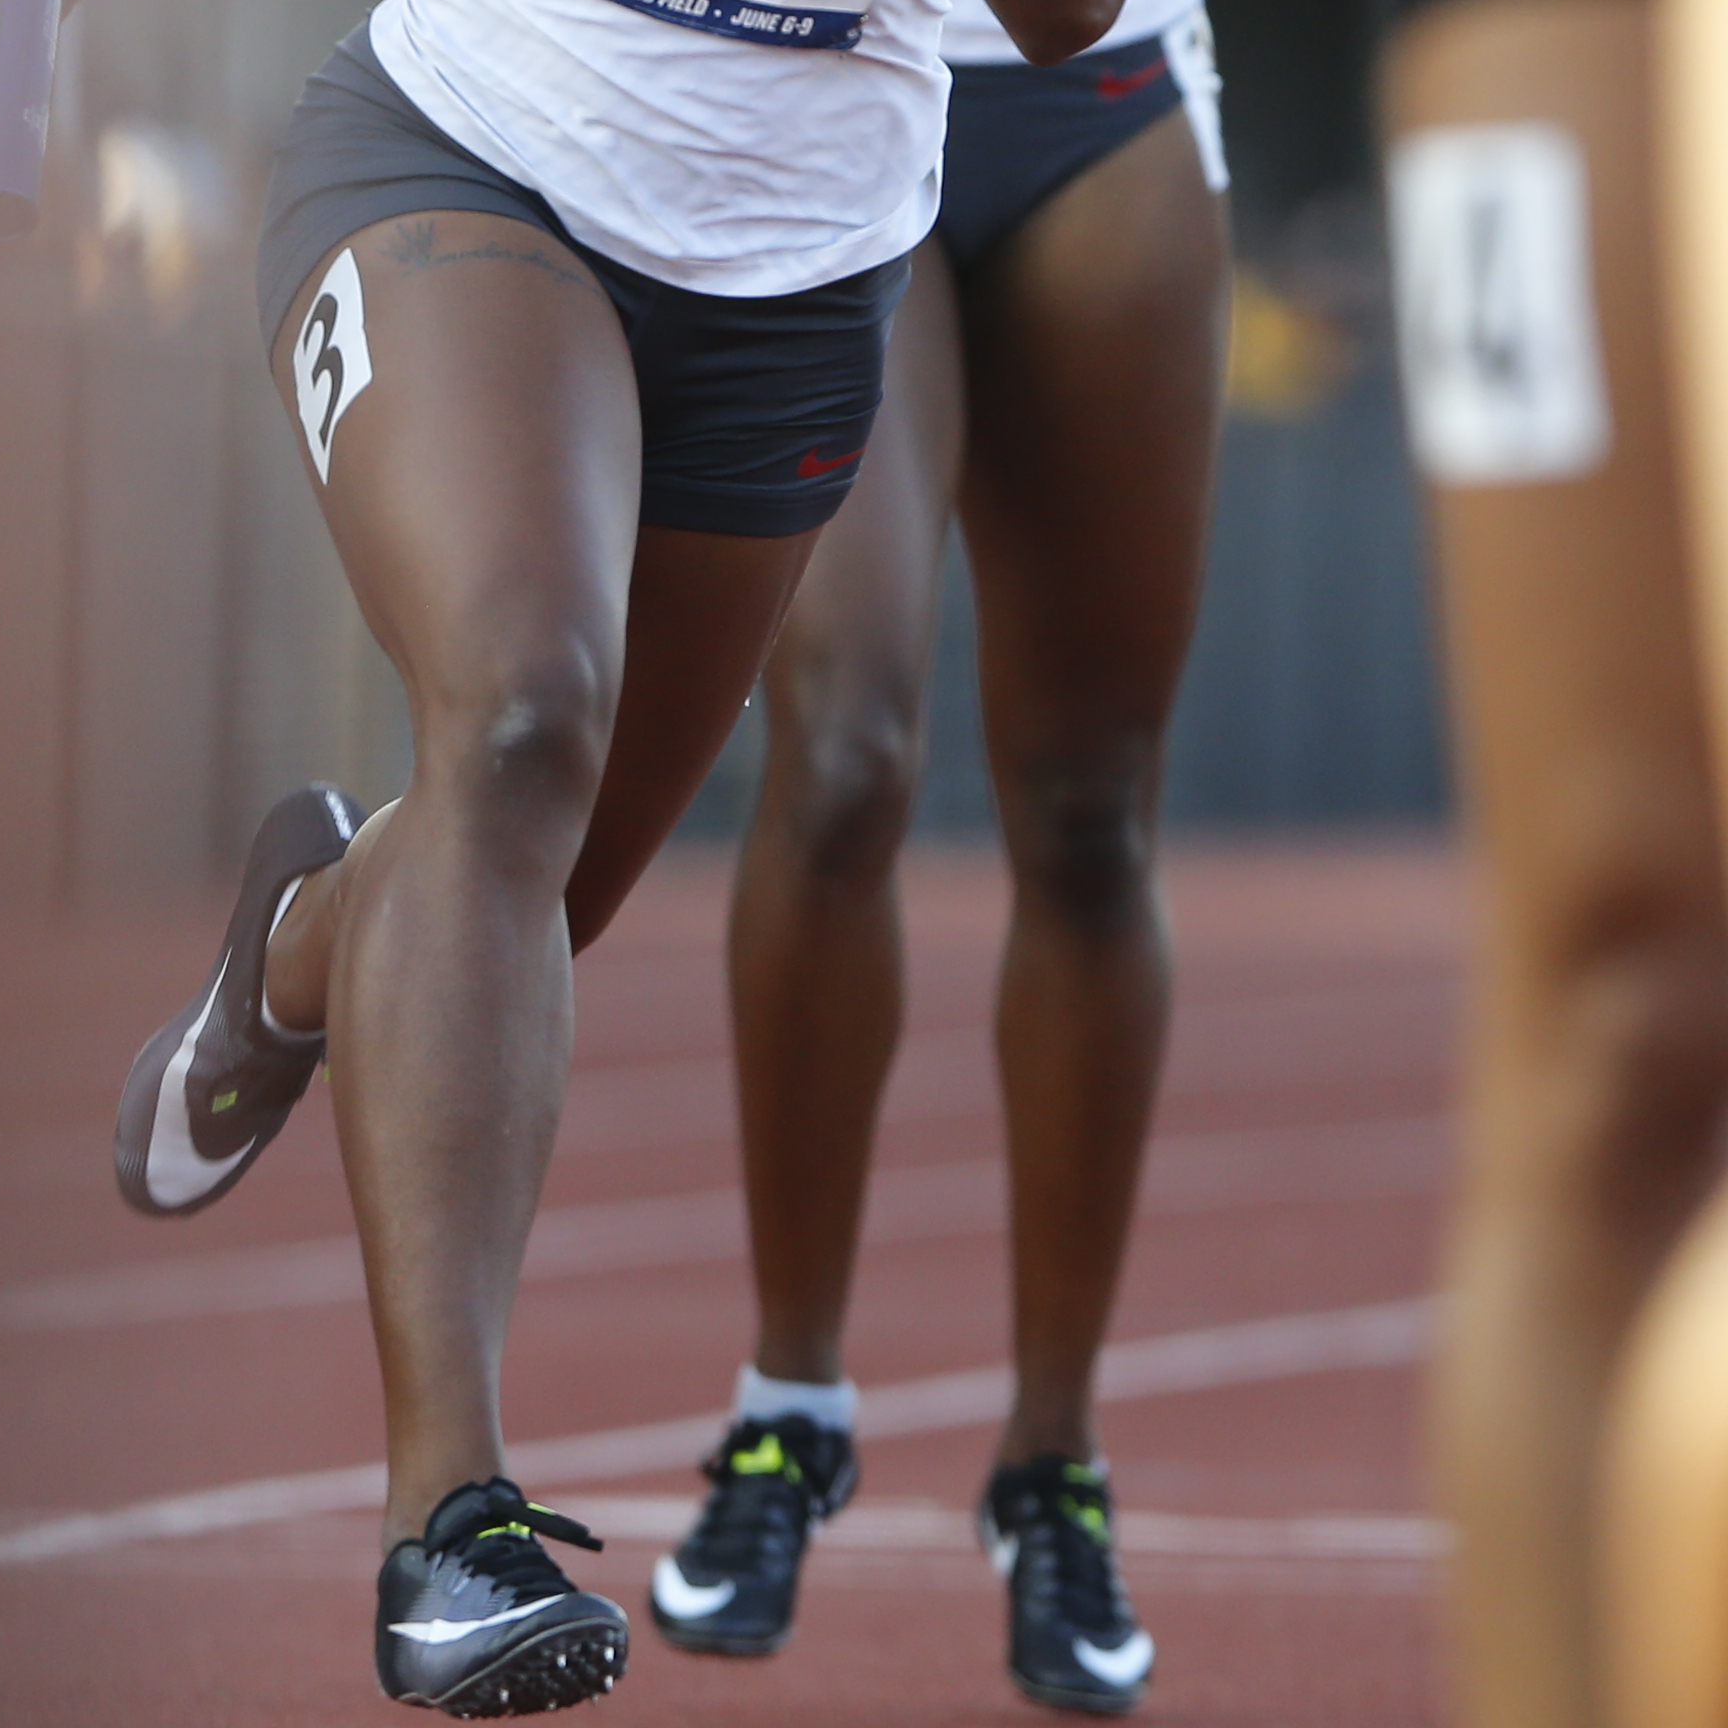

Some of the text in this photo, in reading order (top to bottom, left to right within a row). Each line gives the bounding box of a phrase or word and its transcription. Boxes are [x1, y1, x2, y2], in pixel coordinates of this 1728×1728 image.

[729, 7, 780, 33] JUNE
[780, 13, 816, 37] 6-9
[302, 291, 344, 452] 3
